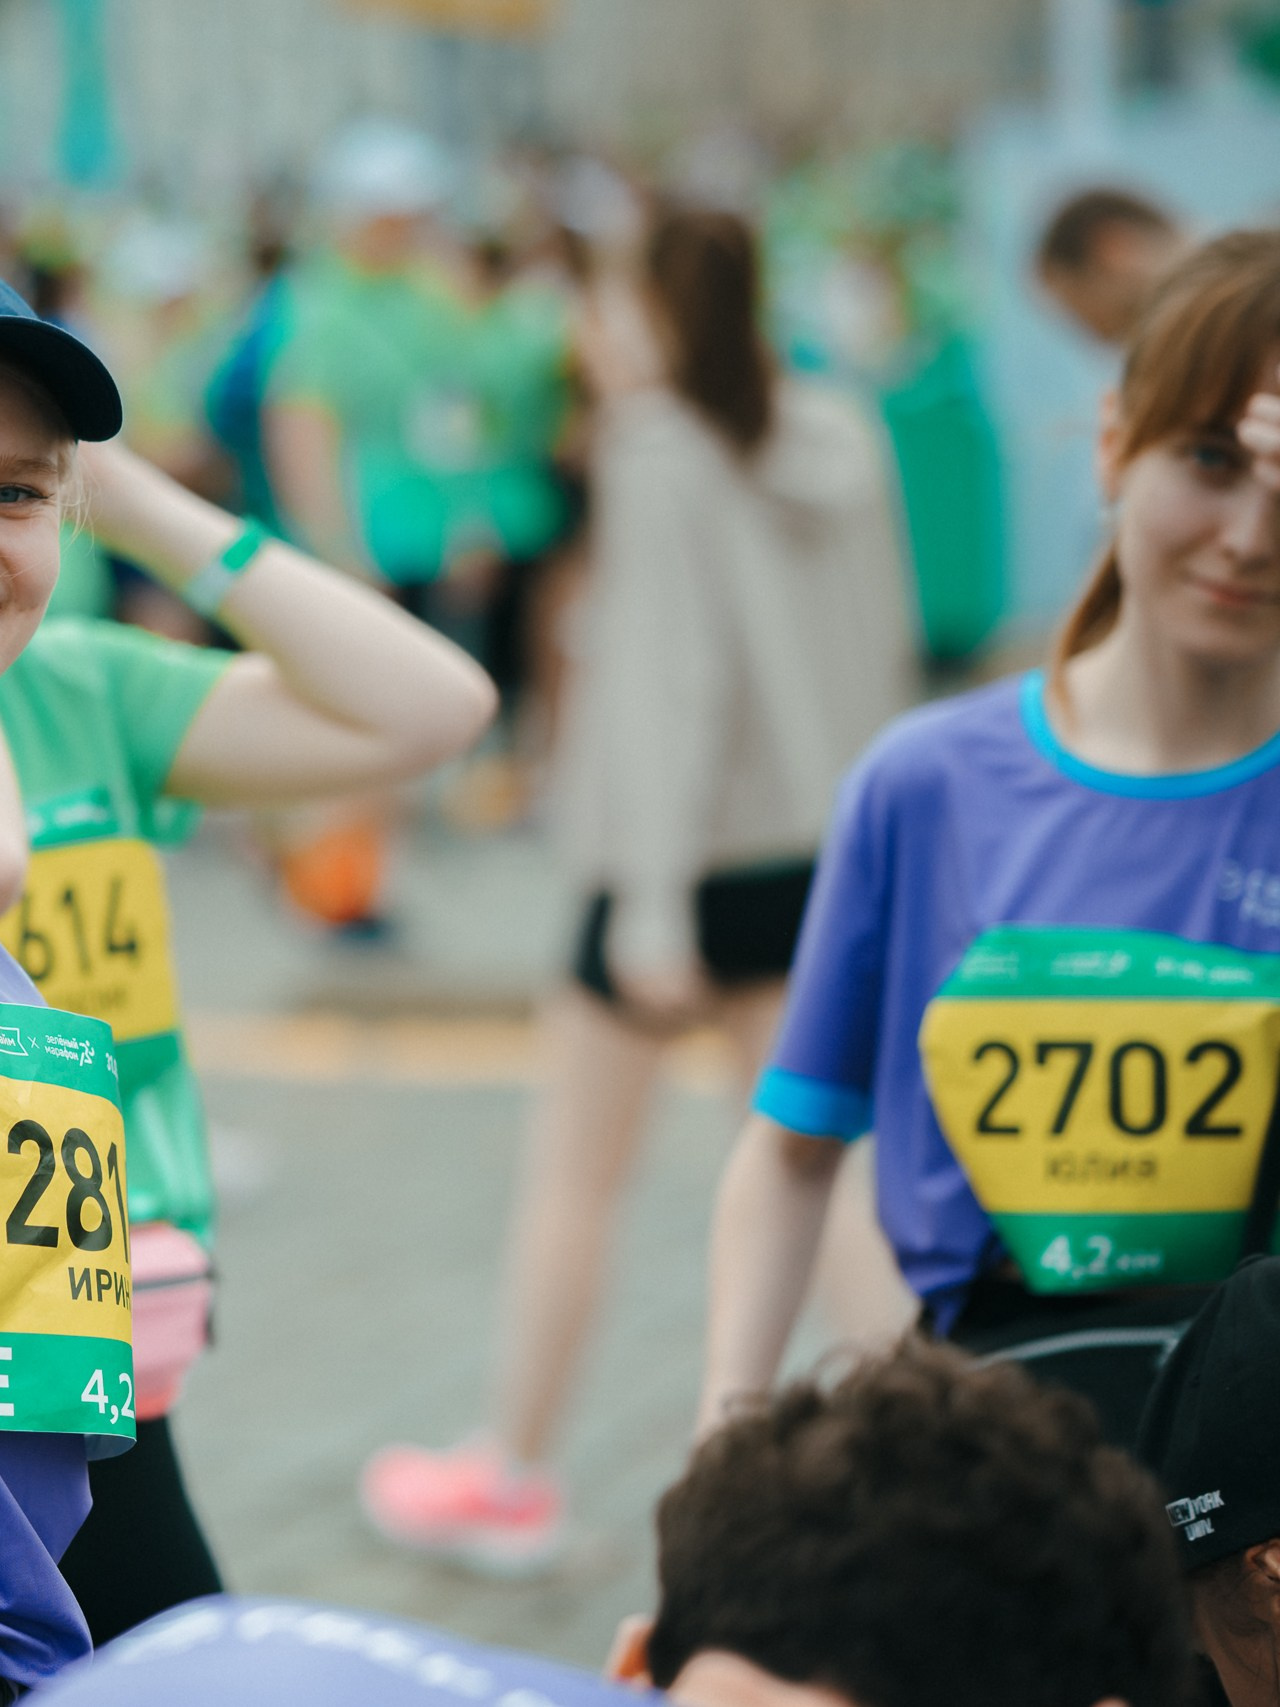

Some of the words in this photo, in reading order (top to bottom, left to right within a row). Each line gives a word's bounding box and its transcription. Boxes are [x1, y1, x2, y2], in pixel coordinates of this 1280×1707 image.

[44, 1046, 79, 1060] марафон
[45, 1034, 79, 1050] зелёный
[974, 1041, 1244, 1137] 2702
[1040, 1235, 1112, 1280] 4,2
[81, 1369, 135, 1424] 4,2
[1192, 1490, 1224, 1514] YORK
